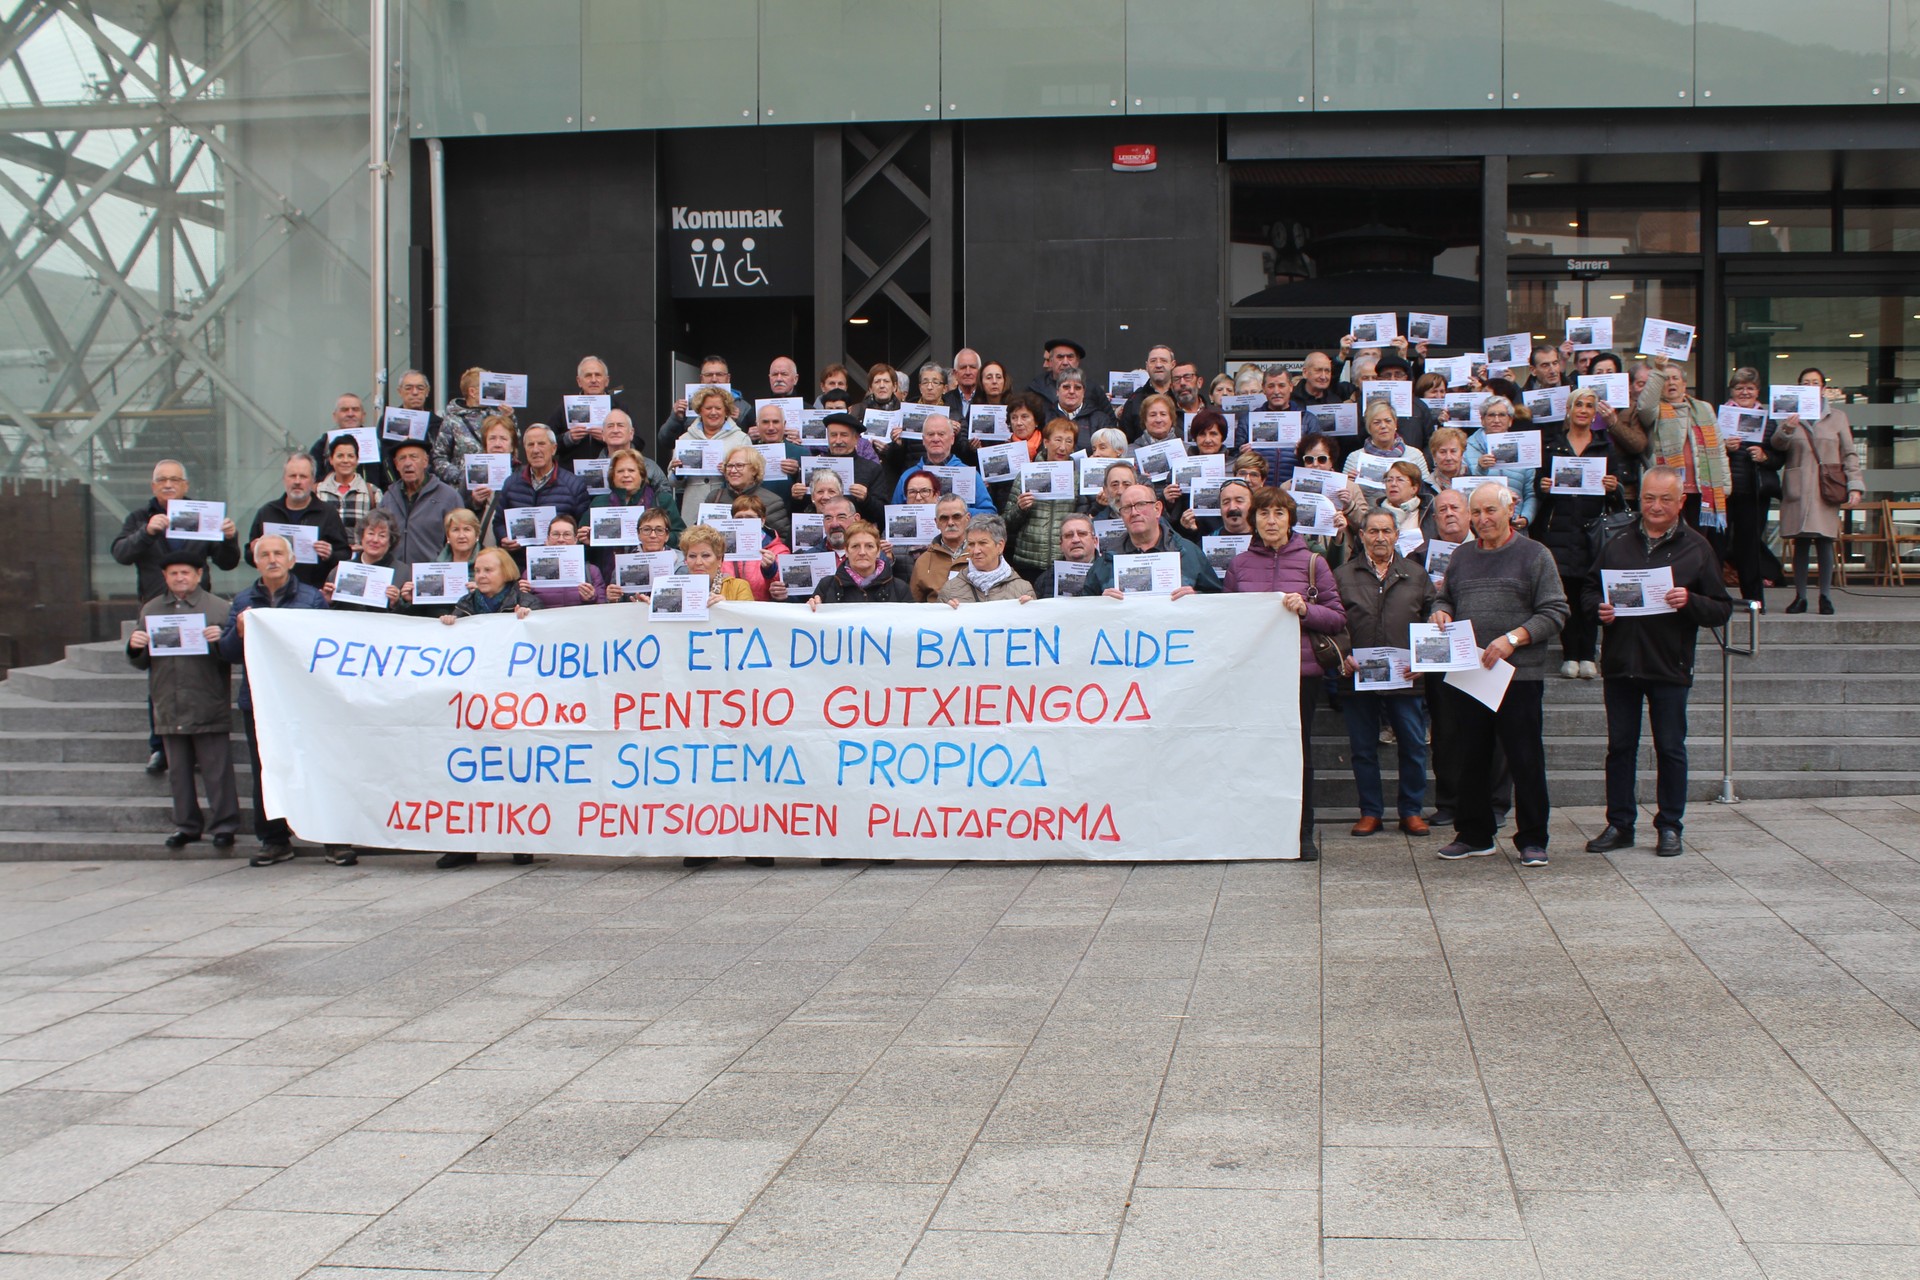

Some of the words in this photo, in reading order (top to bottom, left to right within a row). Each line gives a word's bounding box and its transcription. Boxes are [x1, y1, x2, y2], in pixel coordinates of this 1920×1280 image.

[671, 206, 784, 230] Komunak
[1567, 258, 1610, 270] Sarrera
[310, 637, 476, 678] PENTSIO
[507, 633, 661, 680] PUBLIKO
[687, 627, 773, 672] ETA
[789, 625, 893, 669] DUIN
[915, 624, 1061, 669] BATEN
[1090, 628, 1196, 670] AIDE
[613, 687, 795, 732] PENTSIO
[823, 681, 1152, 729] GUTXIENGOA
[446, 743, 593, 785] GEURE
[610, 742, 807, 790] SISTEMA
[836, 739, 1049, 789] PROPIOA
[386, 799, 551, 836] AZPEITIKO
[578, 801, 838, 839] PENTSIODUNEN
[867, 802, 1121, 842] PLATAFORMA
